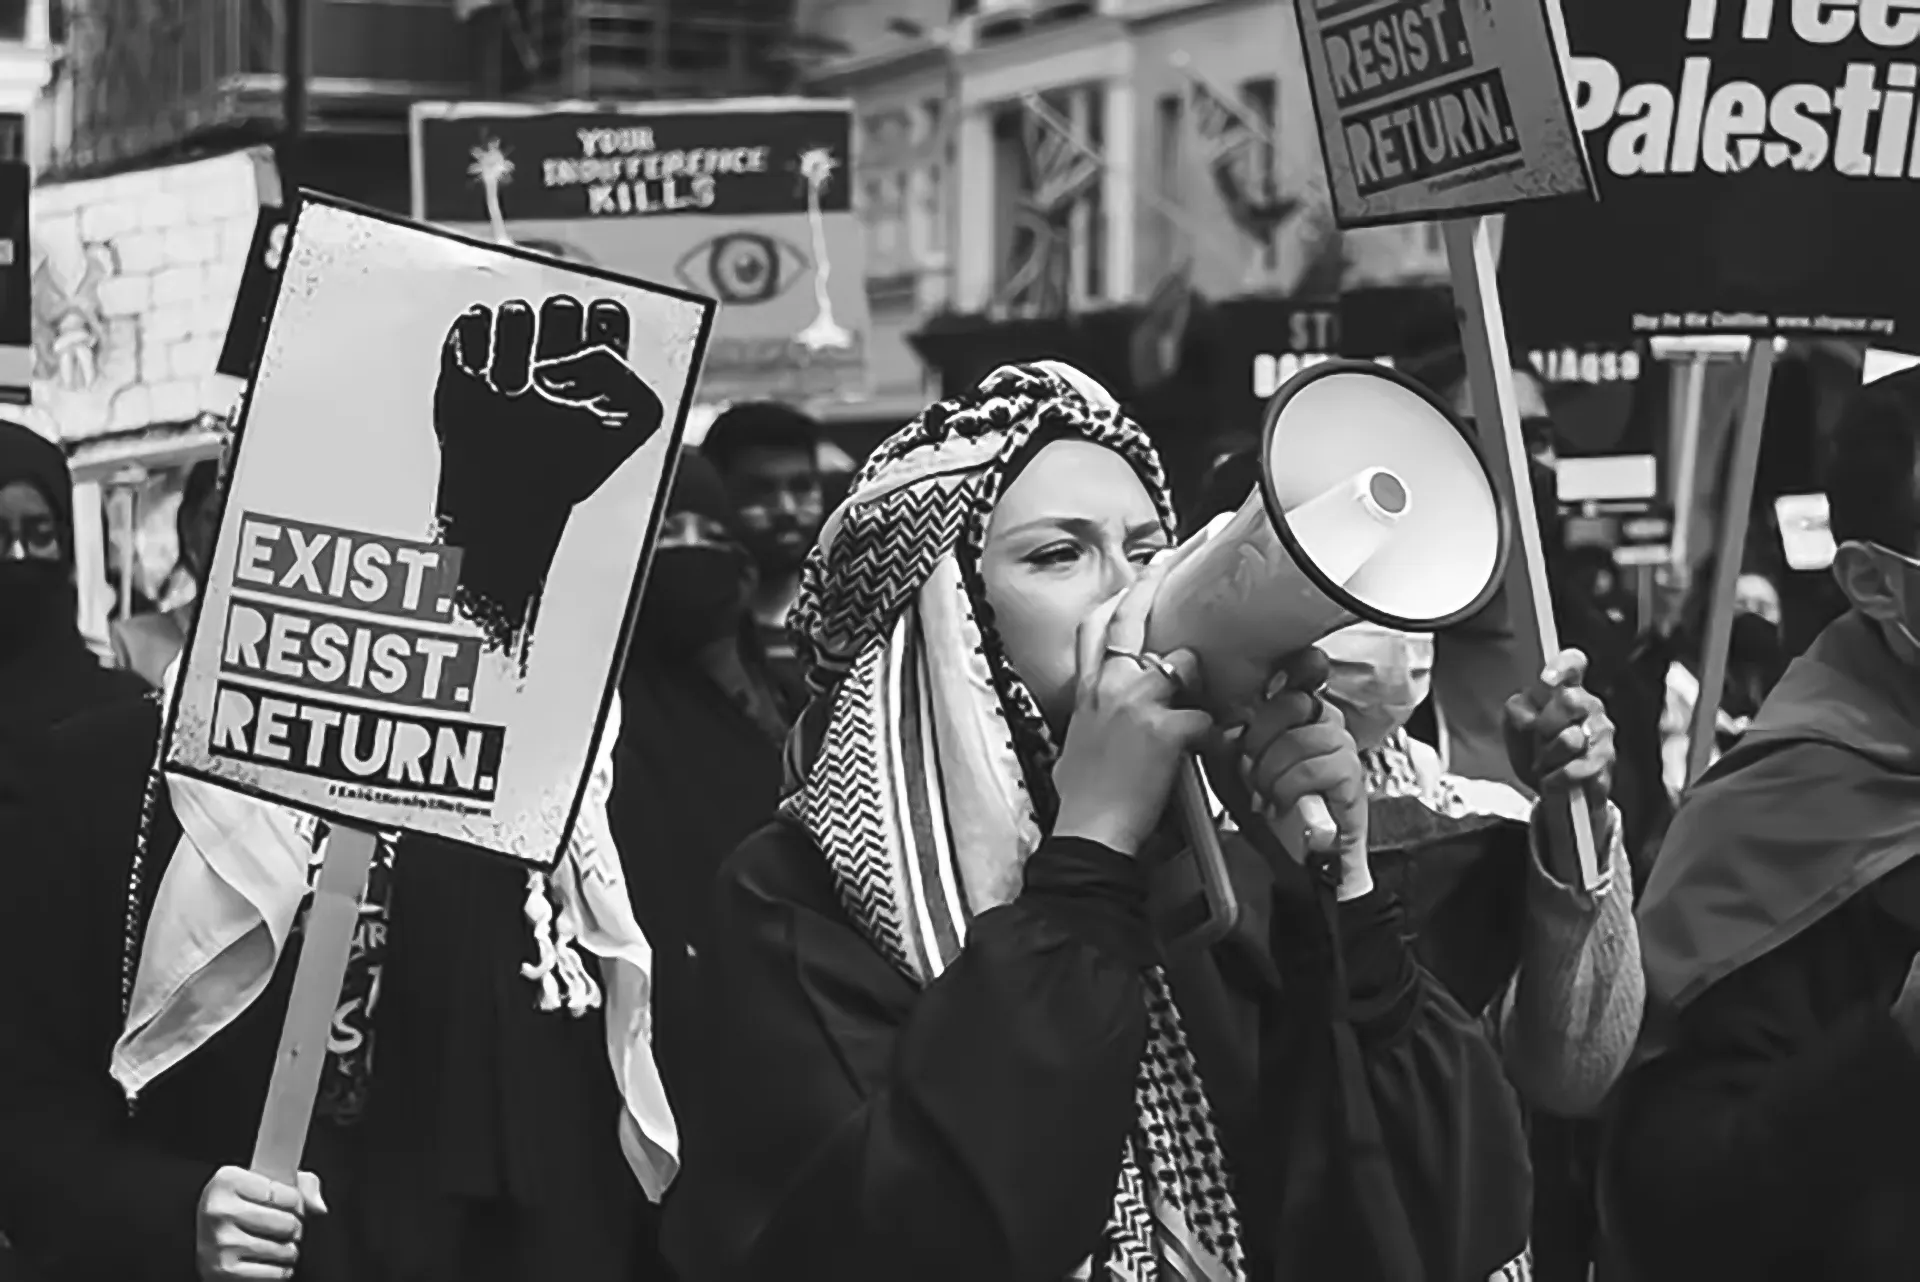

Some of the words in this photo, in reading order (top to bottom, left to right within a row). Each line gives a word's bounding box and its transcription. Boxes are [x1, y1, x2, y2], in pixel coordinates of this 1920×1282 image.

[1324, 2, 1468, 98] RESIST.
[1346, 82, 1514, 186] RETURN.
[1567, 56, 1920, 178] Palesti
[588, 174, 716, 214] KILLS
[237, 518, 451, 614] EXIST.
[224, 604, 470, 701] RESIST.
[212, 687, 494, 791] RETURN.
